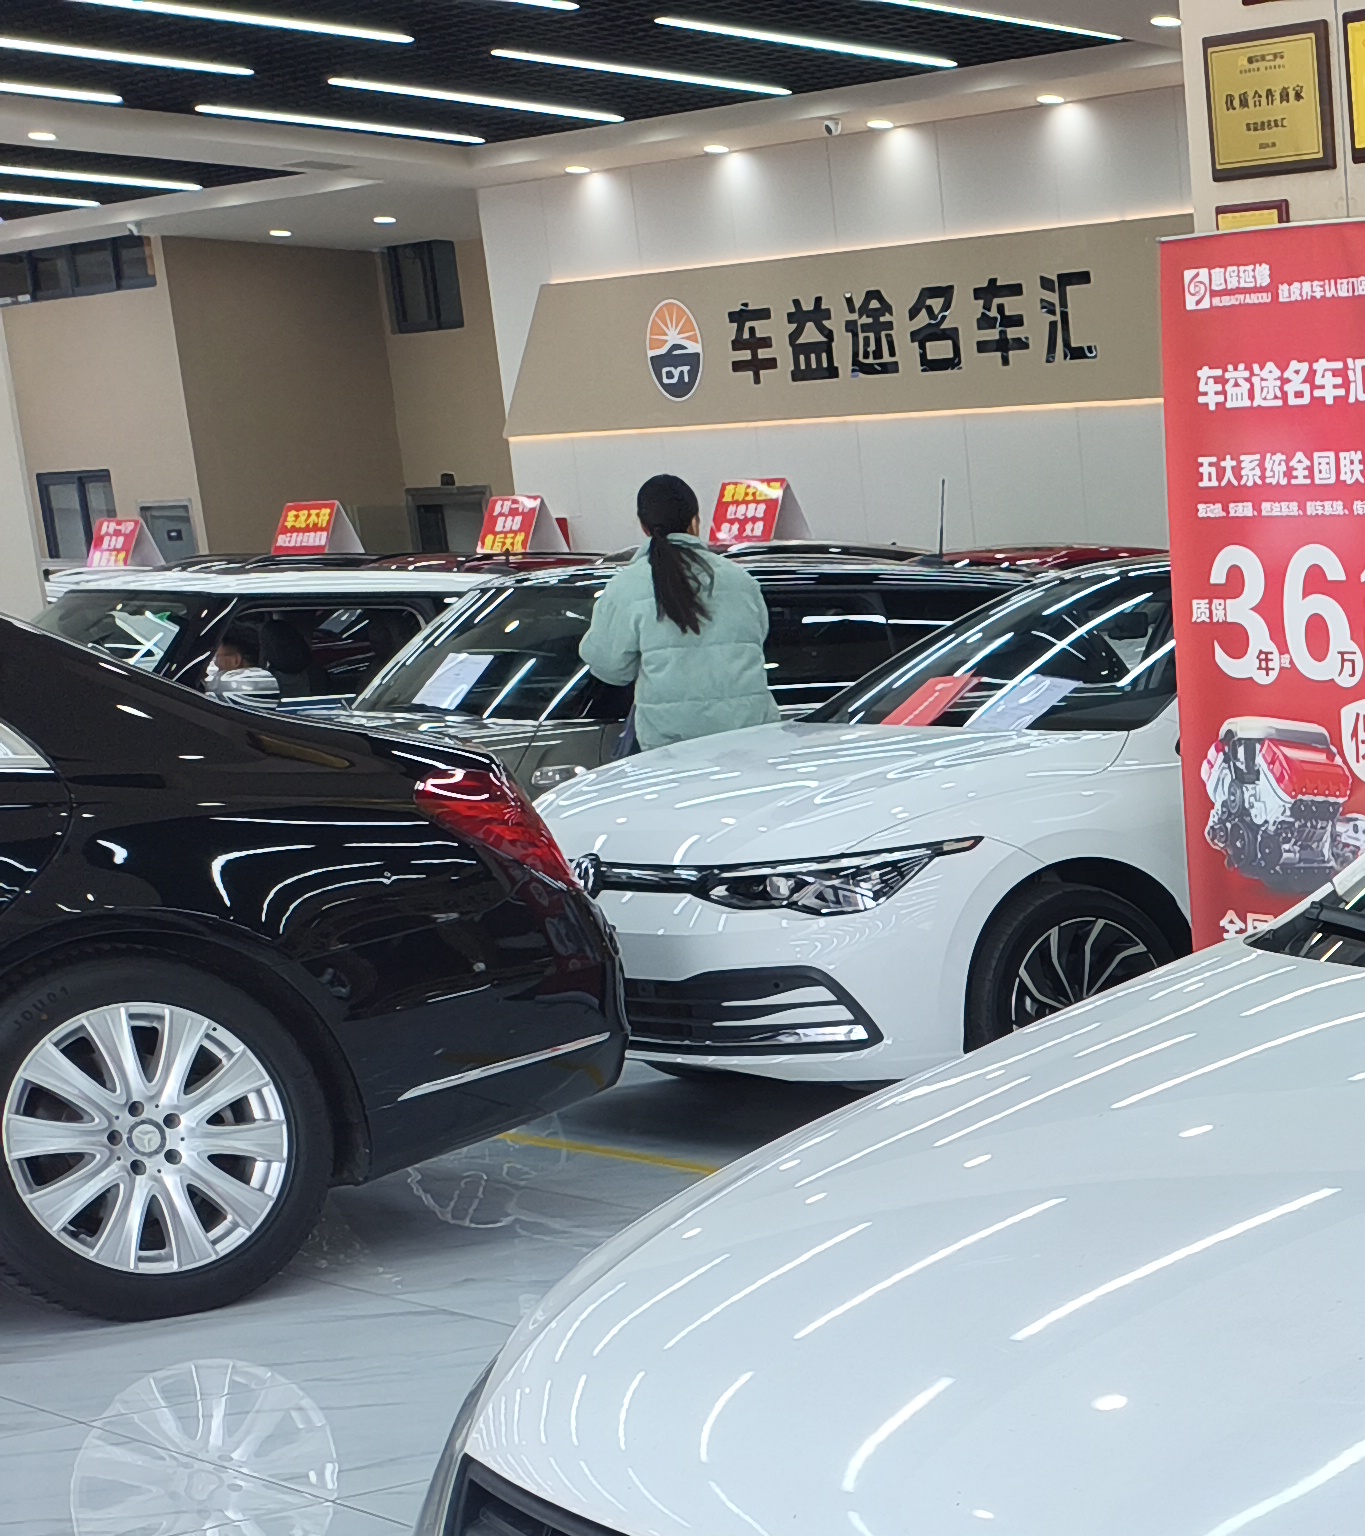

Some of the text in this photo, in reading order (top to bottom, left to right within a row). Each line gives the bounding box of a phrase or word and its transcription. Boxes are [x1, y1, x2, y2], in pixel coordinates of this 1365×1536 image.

[1224, 84, 1305, 112] 优质合作商家
[727, 270, 1098, 385] 车益途名车汇
